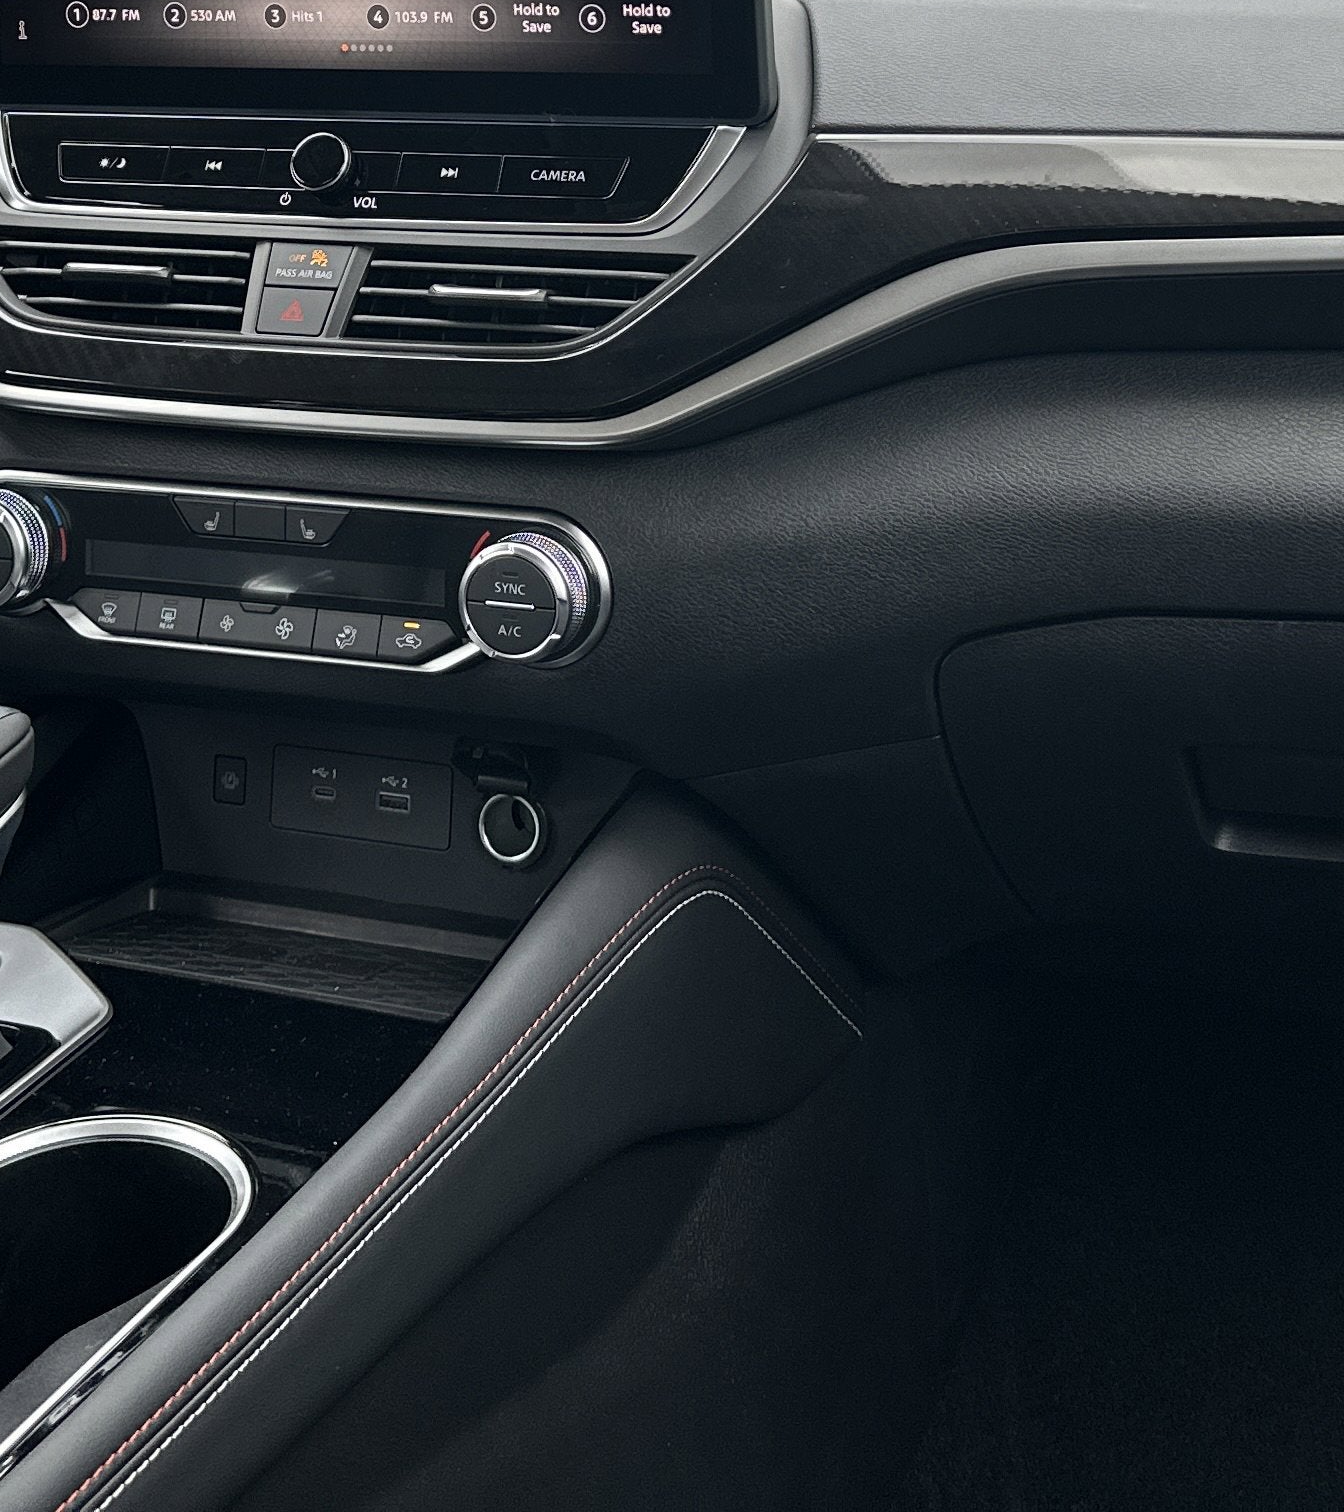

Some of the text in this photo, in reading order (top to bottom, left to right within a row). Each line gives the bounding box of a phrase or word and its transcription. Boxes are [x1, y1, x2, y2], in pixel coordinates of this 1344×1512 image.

[92, 8, 116, 21] 87.7
[122, 10, 141, 21] FM
[190, 10, 212, 22] 530
[215, 10, 236, 22] AM
[292, 10, 314, 22] Hits
[317, 11, 323, 22] 1
[513, 3, 542, 17] Hold
[545, 4, 560, 17] to
[623, 3, 653, 17] Hold
[656, 4, 671, 17] to
[395, 11, 428, 23] 103.9
[434, 12, 454, 24] FM
[522, 20, 552, 34] Save
[632, 21, 662, 35] Save
[530, 169, 586, 182] CAMERA
[353, 196, 378, 209] VOL
[288, 253, 307, 263] OFF
[275, 268, 333, 280] PASS AIR BAG
[494, 581, 526, 596] SYNC
[98, 615, 117, 624] FRONT
[159, 622, 175, 631] REAR
[497, 625, 522, 638] A/C
[401, 778, 409, 789] 2
